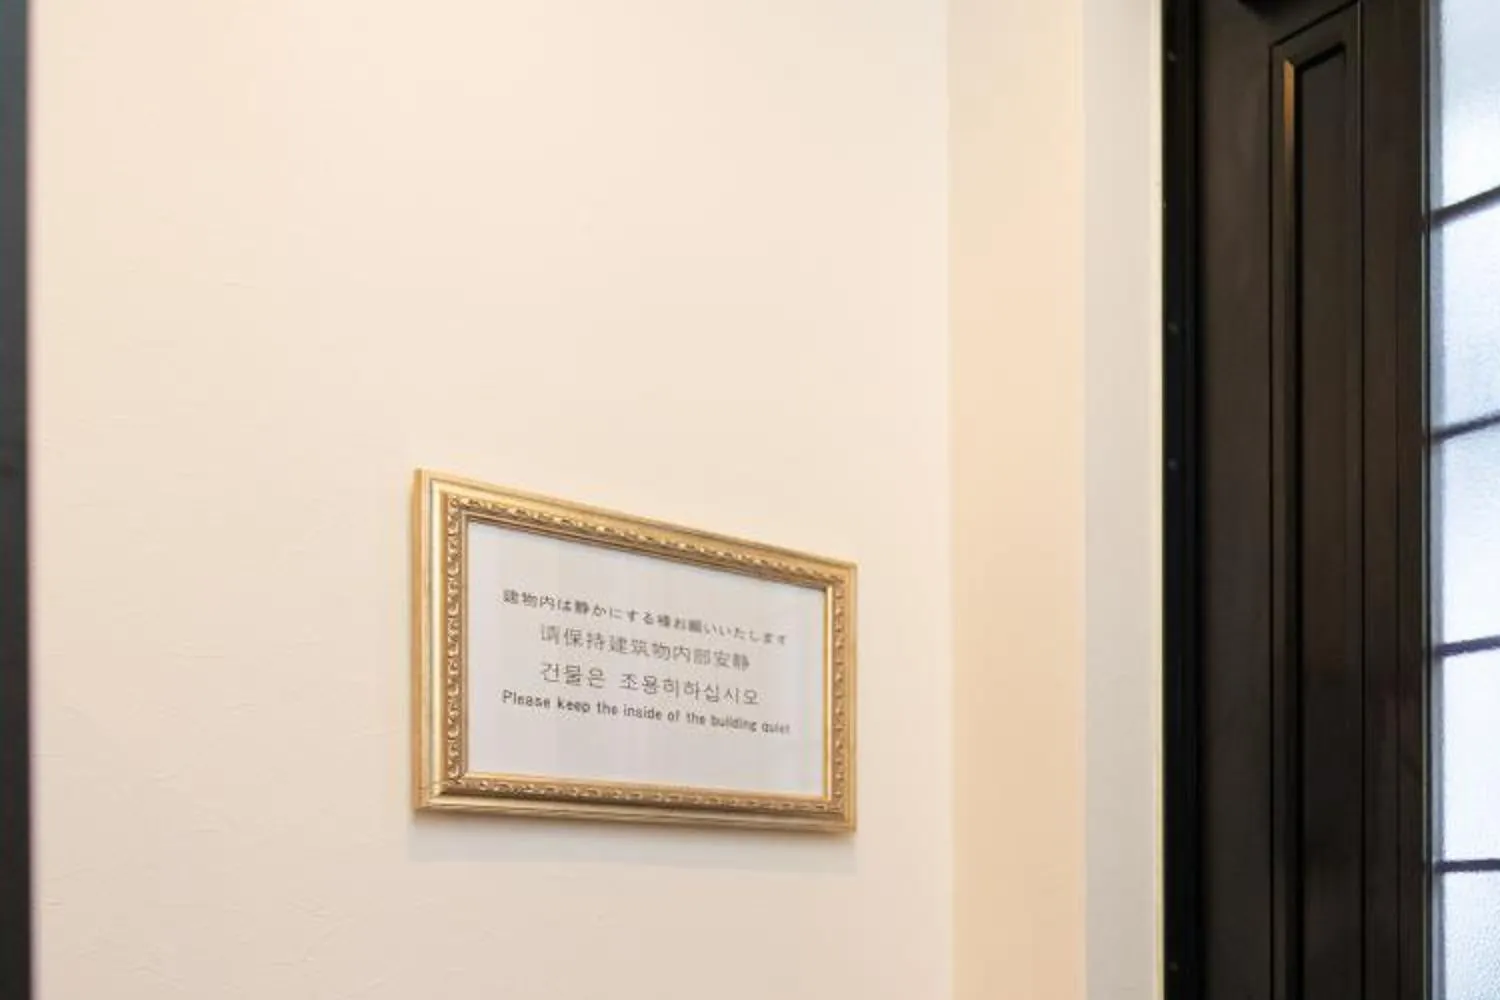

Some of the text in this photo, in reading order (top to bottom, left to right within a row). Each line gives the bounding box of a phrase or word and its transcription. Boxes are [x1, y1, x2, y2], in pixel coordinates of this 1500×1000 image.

[540, 662, 759, 704] 건물은 조용히하십시오
[502, 689, 790, 734] Please keep the inside of the building quiet
